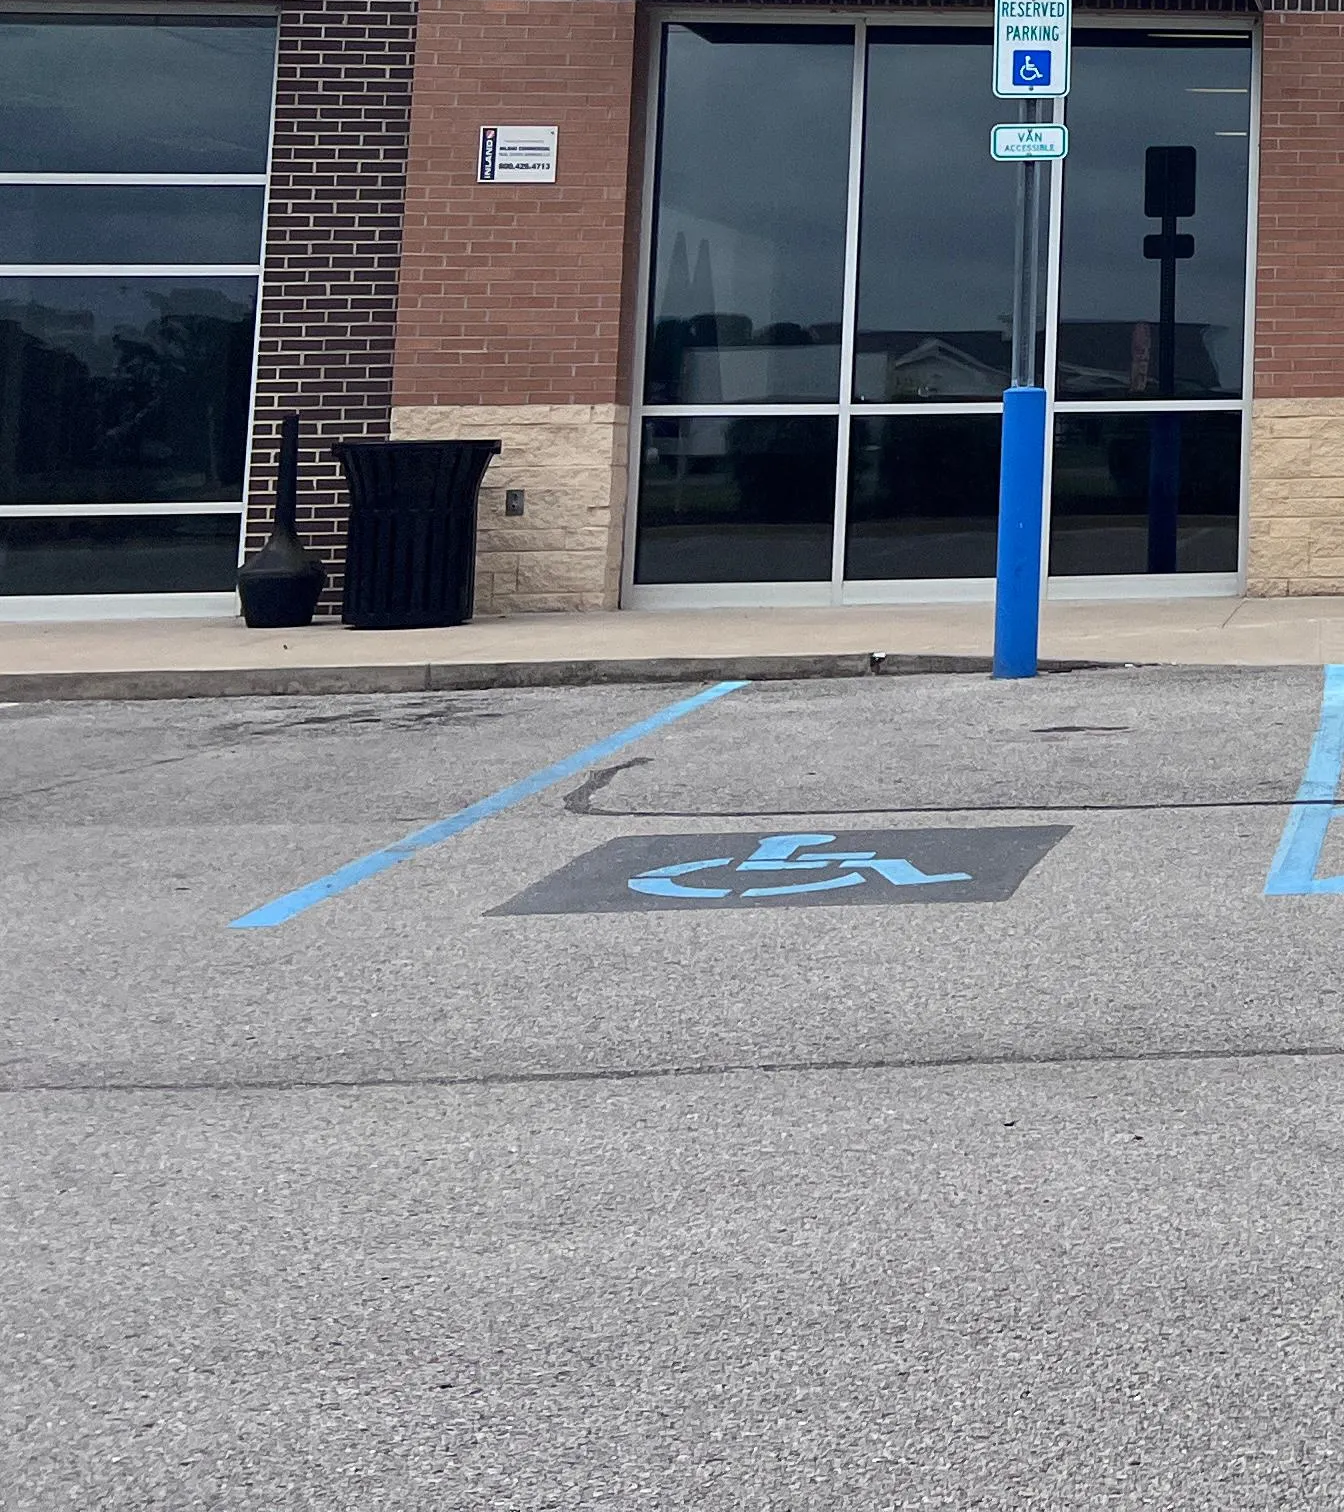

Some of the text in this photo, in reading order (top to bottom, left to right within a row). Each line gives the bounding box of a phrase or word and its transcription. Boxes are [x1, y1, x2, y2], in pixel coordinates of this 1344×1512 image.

[1002, 1, 1065, 18] RESERVED
[1006, 25, 1060, 41] PARKING
[1018, 132, 1042, 142] VAN
[1004, 144, 1055, 152] ACCESSIBLE
[484, 140, 494, 179] INLAND
